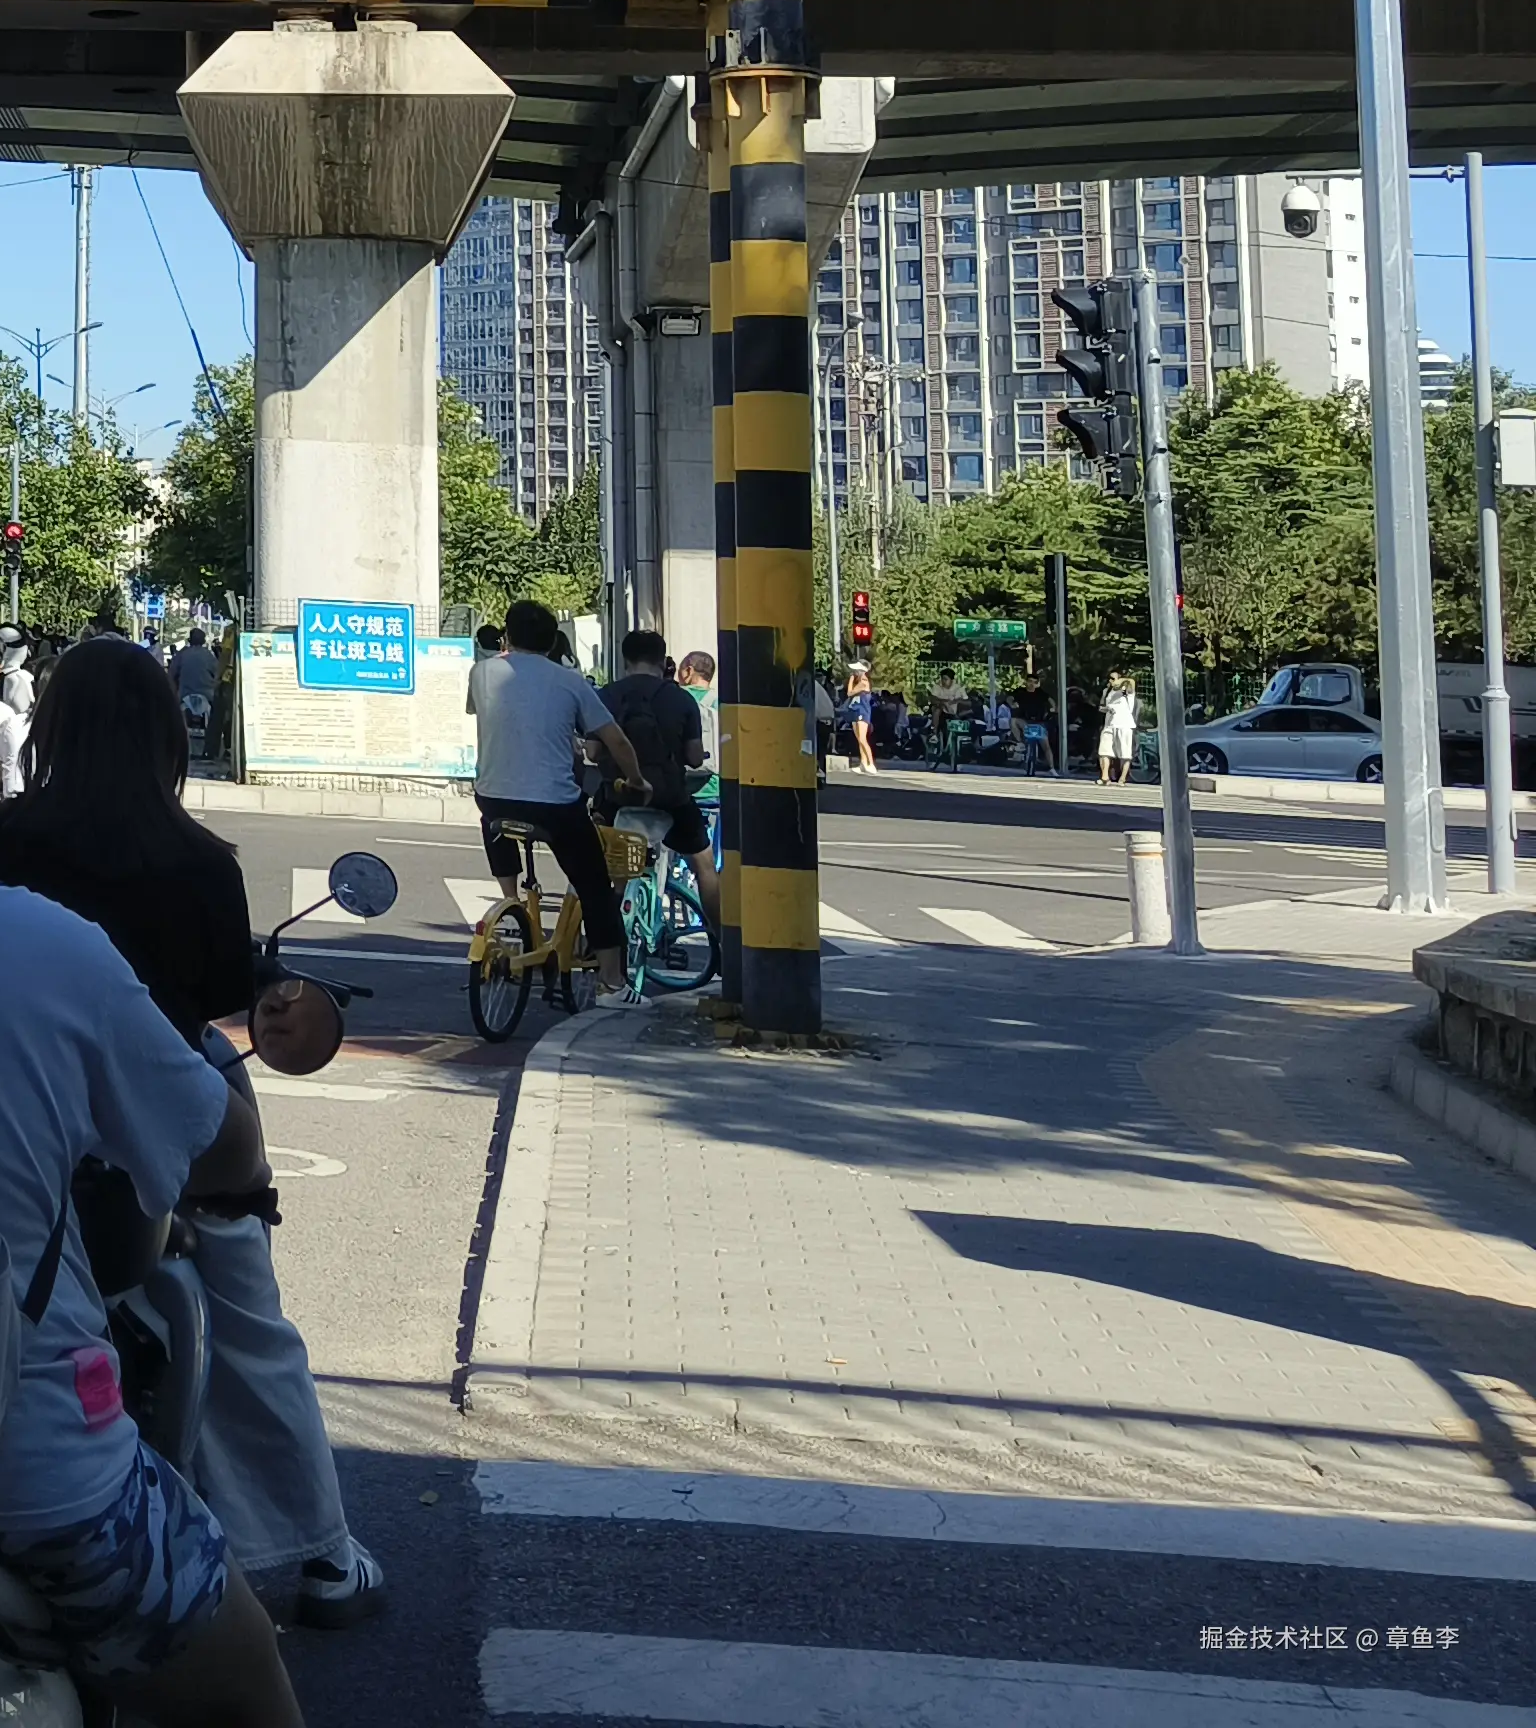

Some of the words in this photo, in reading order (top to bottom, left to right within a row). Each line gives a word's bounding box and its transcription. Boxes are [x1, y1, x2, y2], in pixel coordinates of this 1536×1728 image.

[309, 613, 405, 637] 人人守规范
[309, 639, 405, 663] 车让斑马线
